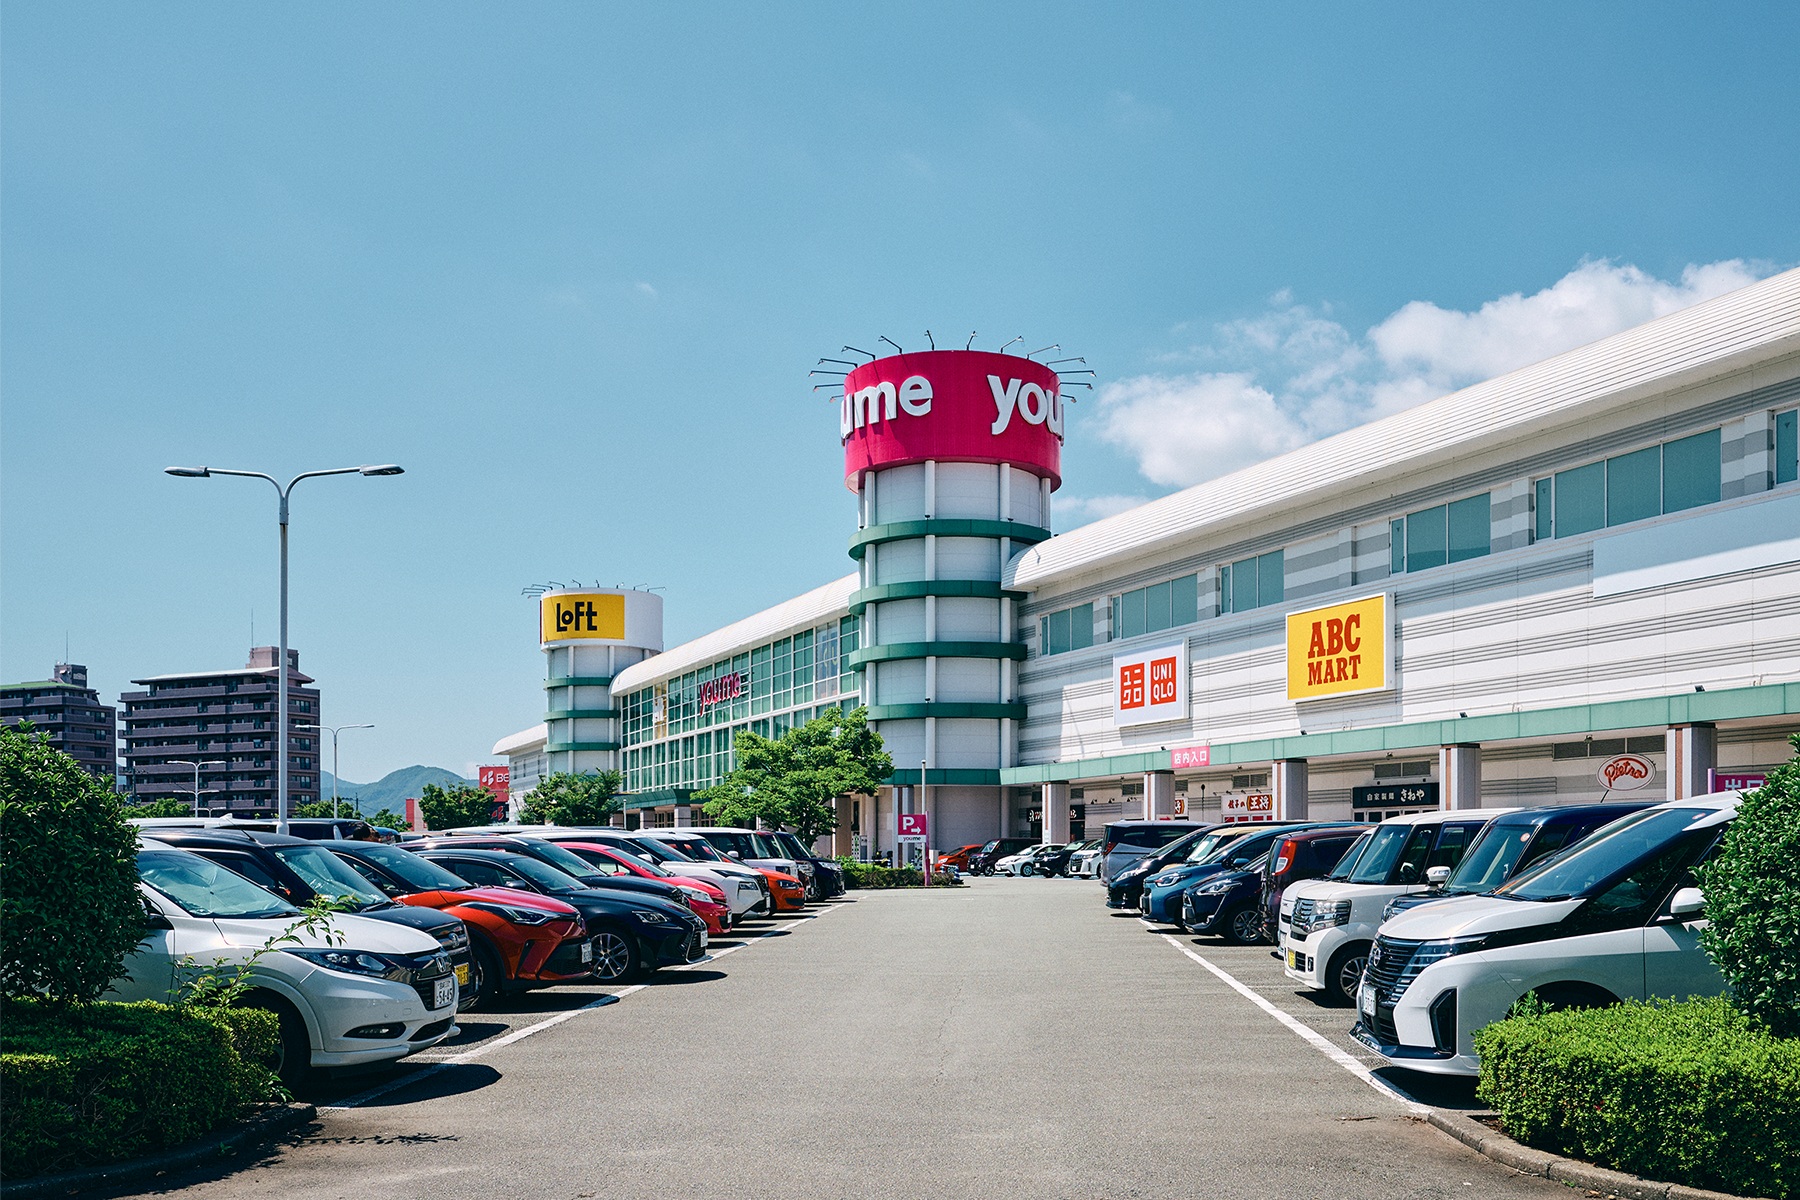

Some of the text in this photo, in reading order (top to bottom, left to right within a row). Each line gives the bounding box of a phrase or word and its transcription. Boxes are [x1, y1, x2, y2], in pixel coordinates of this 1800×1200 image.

[987, 374, 1064, 442] you
[1308, 613, 1361, 659] ABC
[1153, 662, 1173, 681] UNI
[1308, 654, 1361, 686] MART
[699, 672, 741, 717] youme
[1153, 681, 1174, 702] QLO
[1174, 750, 1207, 765] 店内入口
[902, 816, 915, 831] P
